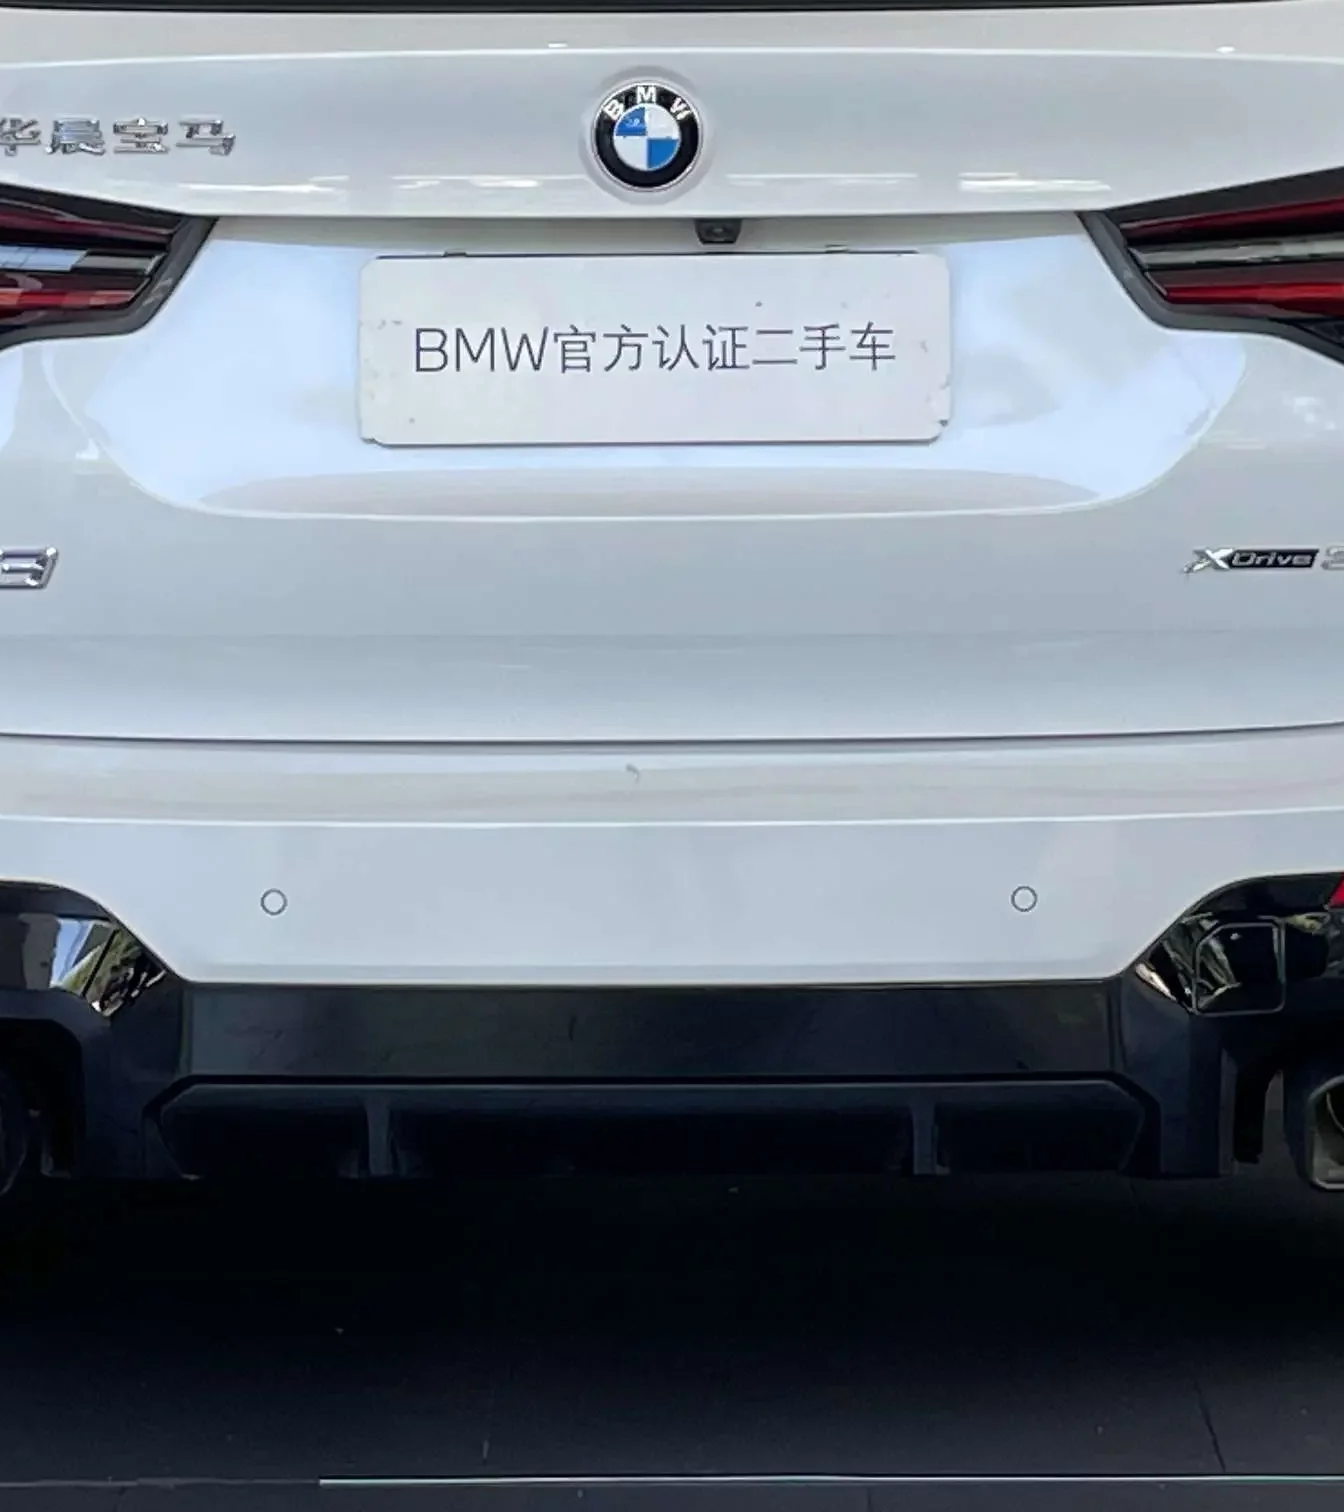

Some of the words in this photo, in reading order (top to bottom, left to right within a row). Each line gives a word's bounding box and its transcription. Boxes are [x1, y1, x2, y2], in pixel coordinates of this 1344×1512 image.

[603, 85, 692, 121] BMW
[414, 321, 896, 374] BMW官方认证二手车
